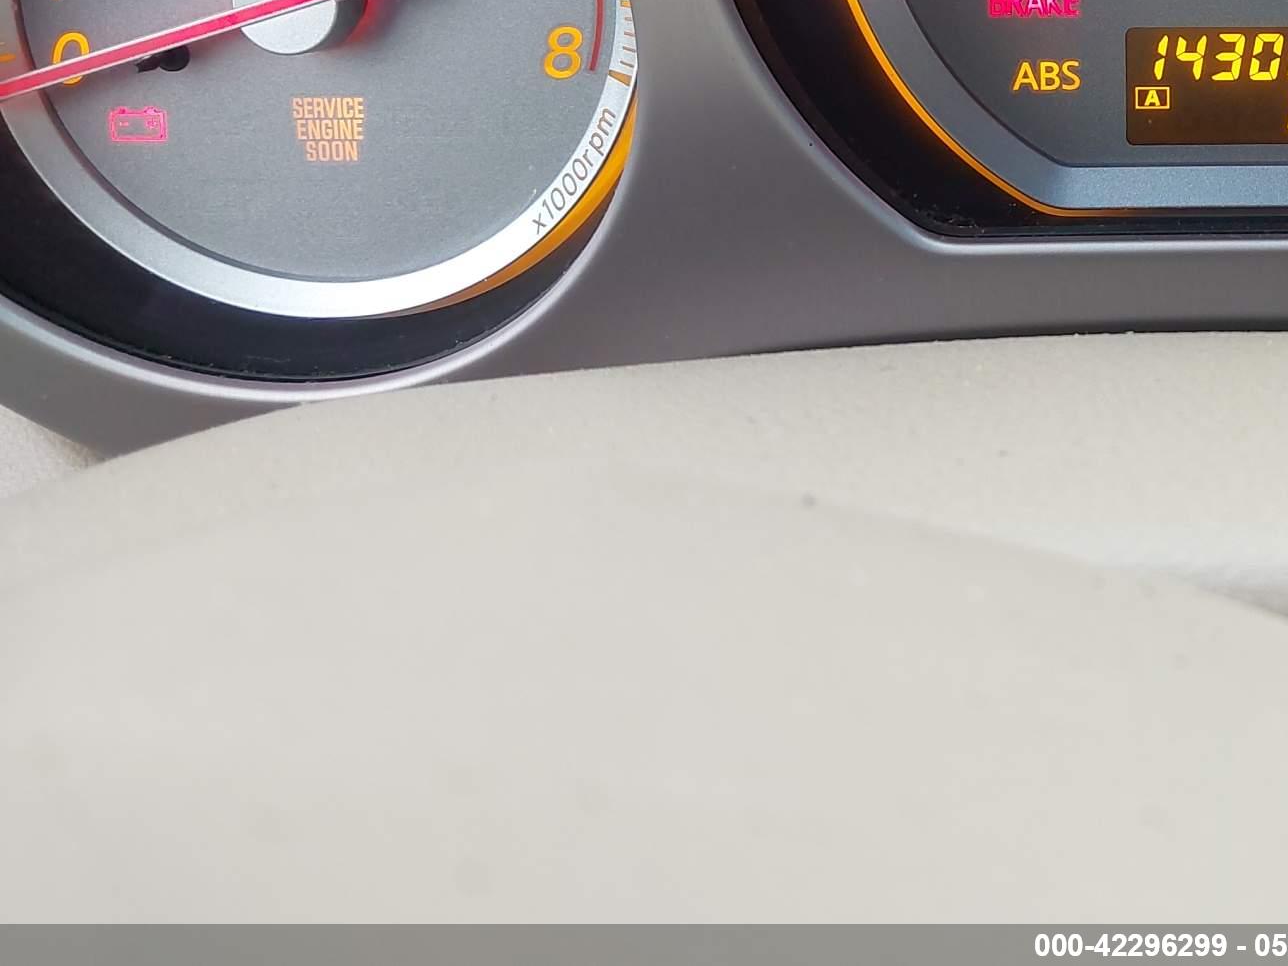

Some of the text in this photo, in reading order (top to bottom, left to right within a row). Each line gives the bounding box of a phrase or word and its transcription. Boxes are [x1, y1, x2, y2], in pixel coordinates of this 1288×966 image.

[52, 32, 91, 85] 0
[543, 26, 583, 79] 8
[1012, 60, 1081, 91] ABS
[292, 97, 364, 118] SERVICE
[1144, 89, 1161, 107] A
[297, 119, 364, 139] ENGINE
[305, 140, 358, 161] SOON
[532, 107, 616, 235] x1000rpm
